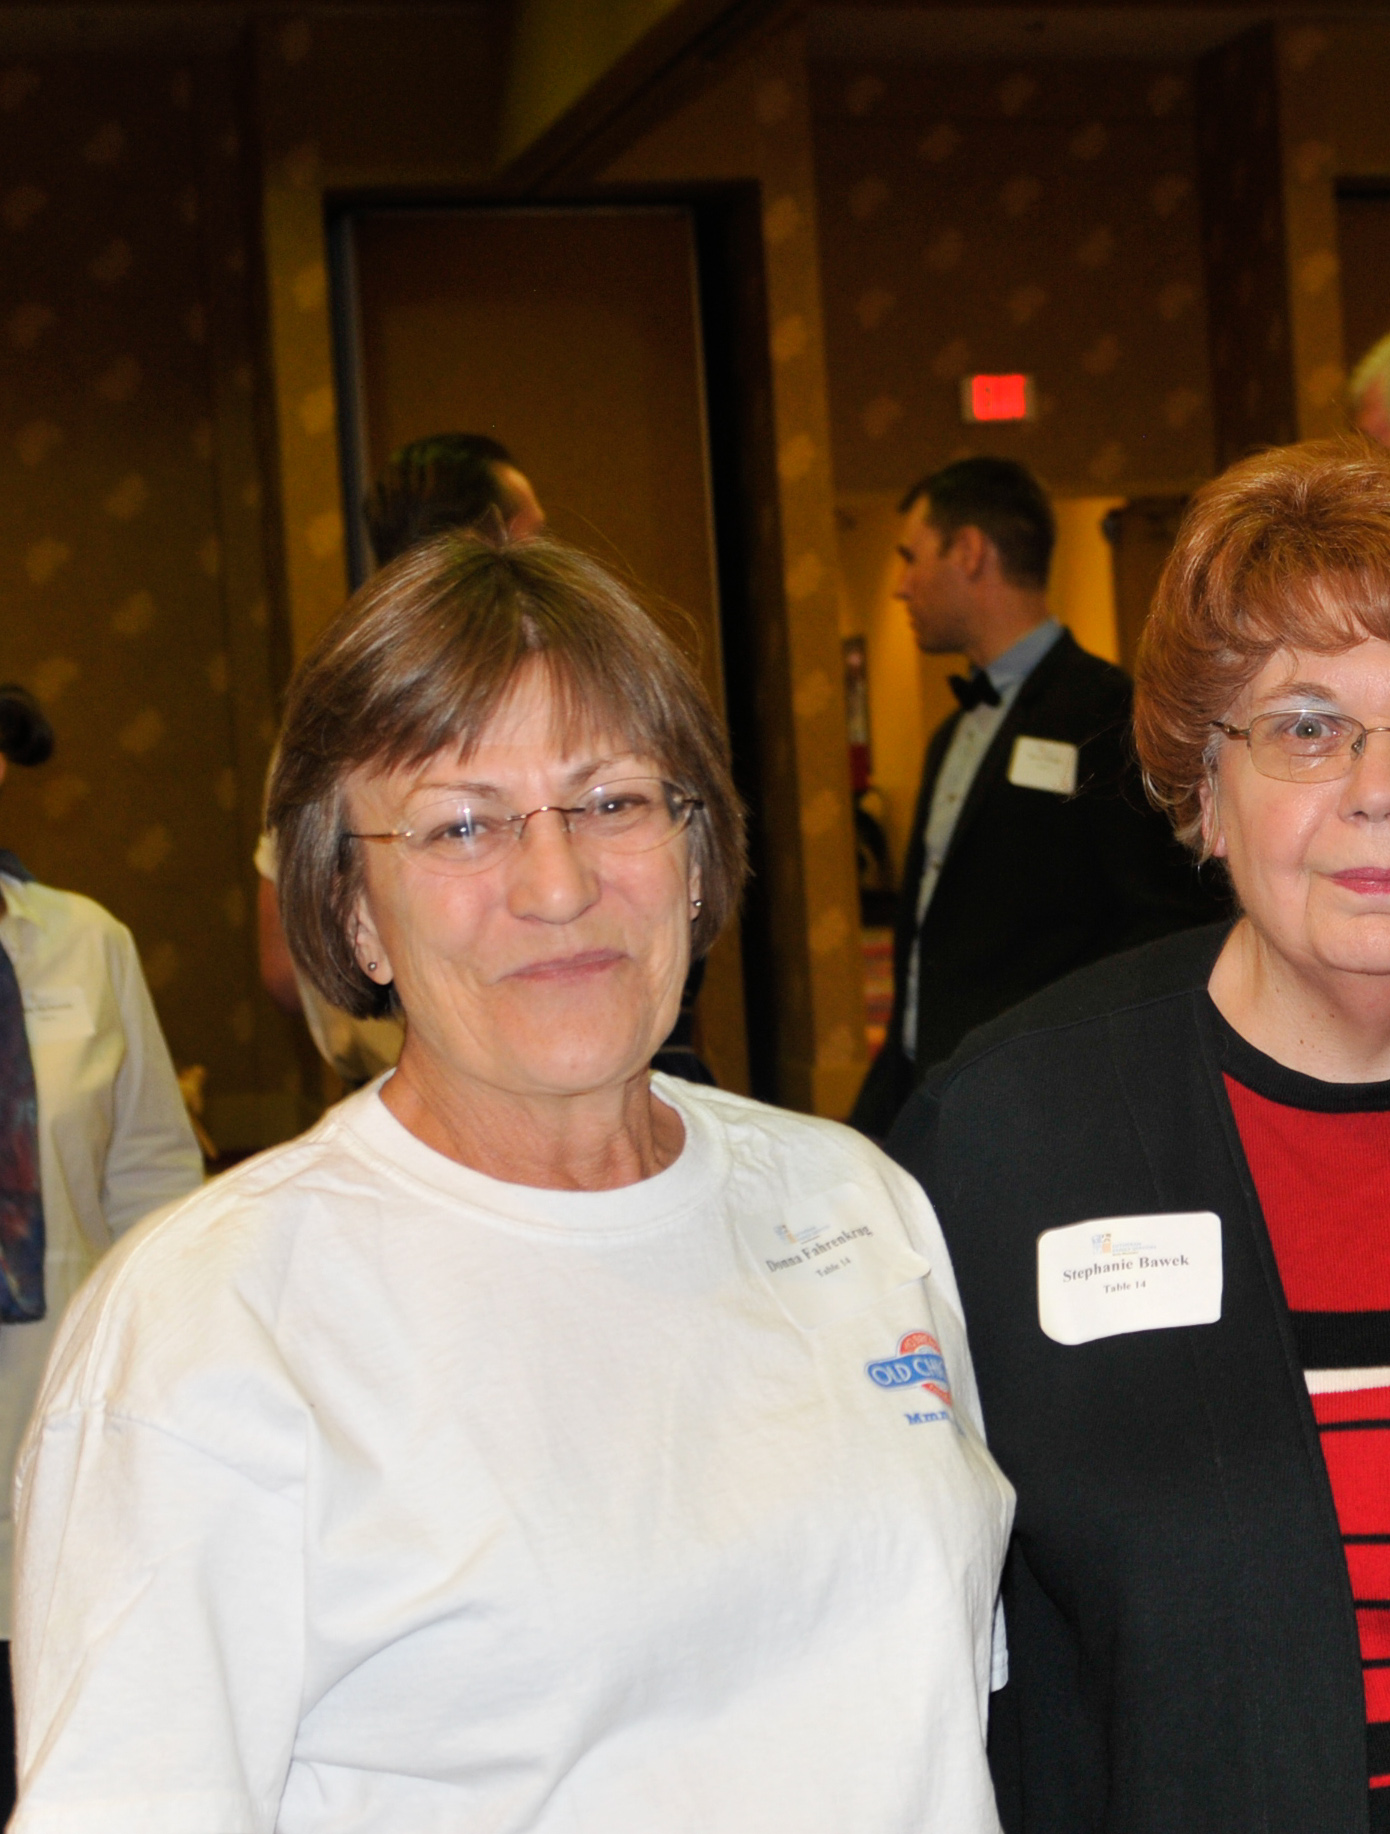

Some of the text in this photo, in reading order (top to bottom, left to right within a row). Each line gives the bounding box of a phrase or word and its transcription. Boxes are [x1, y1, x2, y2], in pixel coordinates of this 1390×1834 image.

[765, 1255, 803, 1273] Donna
[802, 1225, 874, 1260] Fahrenkrug
[815, 1263, 840, 1278] Table
[1063, 1254, 1190, 1283] Stephanie Bawek
[1103, 1280, 1146, 1294] Table 14
[871, 1362, 912, 1386] OLD
